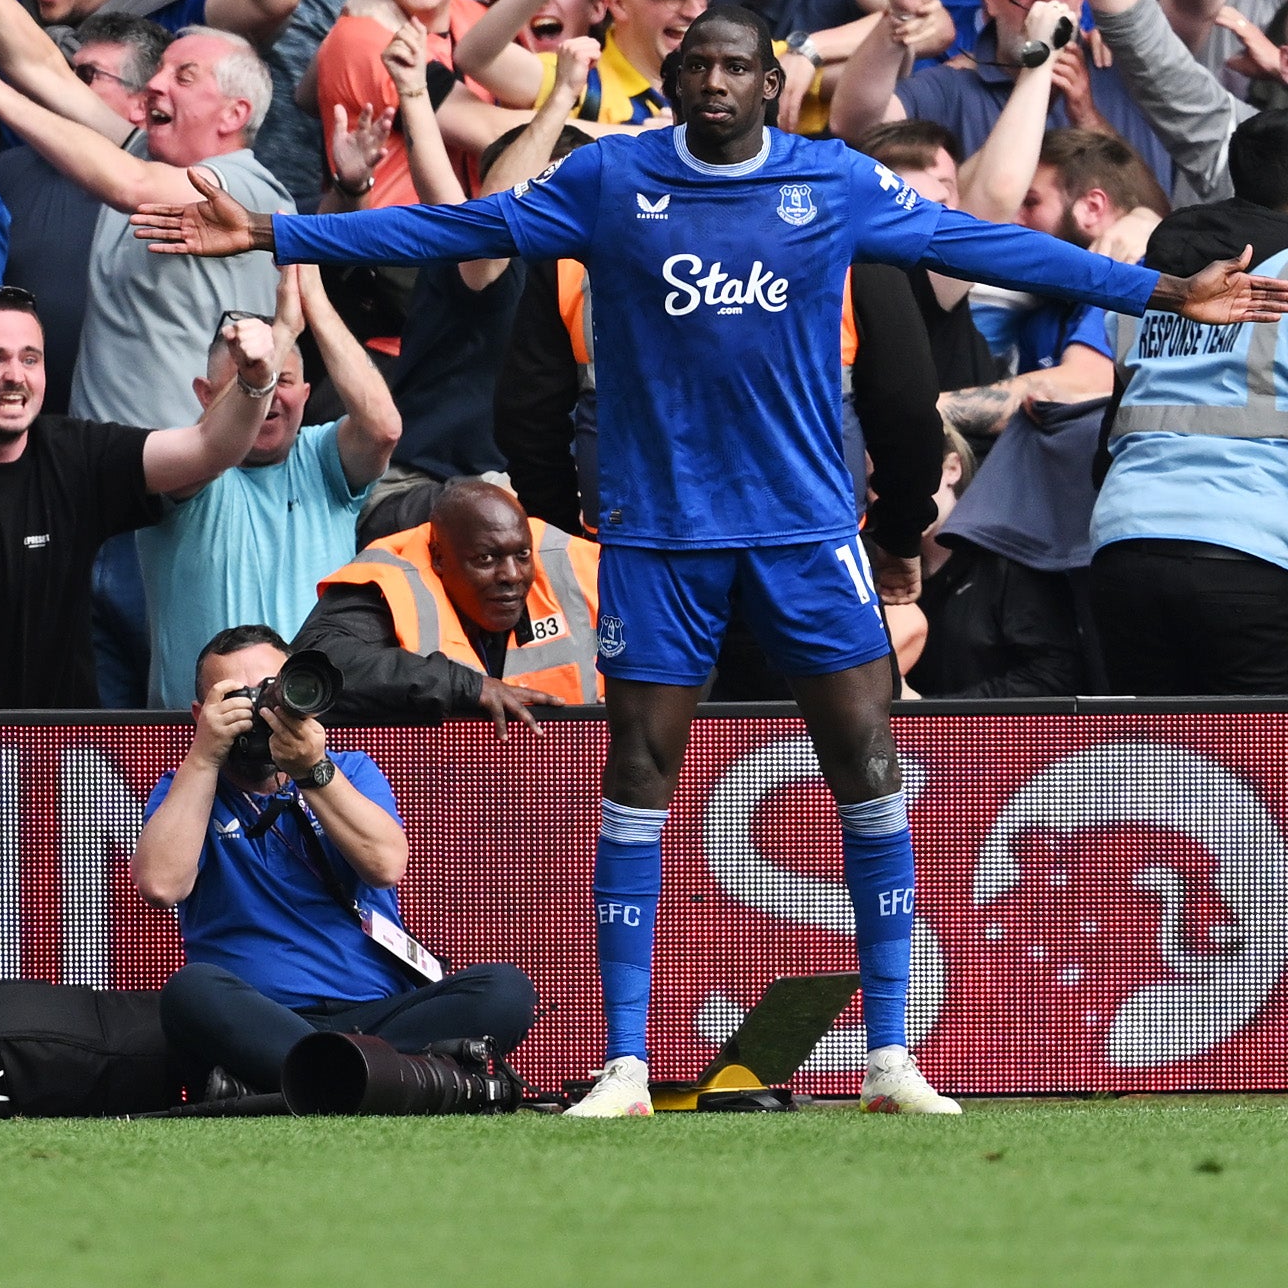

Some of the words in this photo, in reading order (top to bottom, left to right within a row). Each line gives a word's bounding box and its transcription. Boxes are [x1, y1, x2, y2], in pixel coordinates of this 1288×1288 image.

[662, 253, 789, 316] Stake
[716, 306, 743, 315] .com
[1138, 314, 1203, 360] RESPONSE
[534, 616, 560, 640] 83
[597, 903, 641, 927] EFC
[878, 887, 913, 917] EFC
